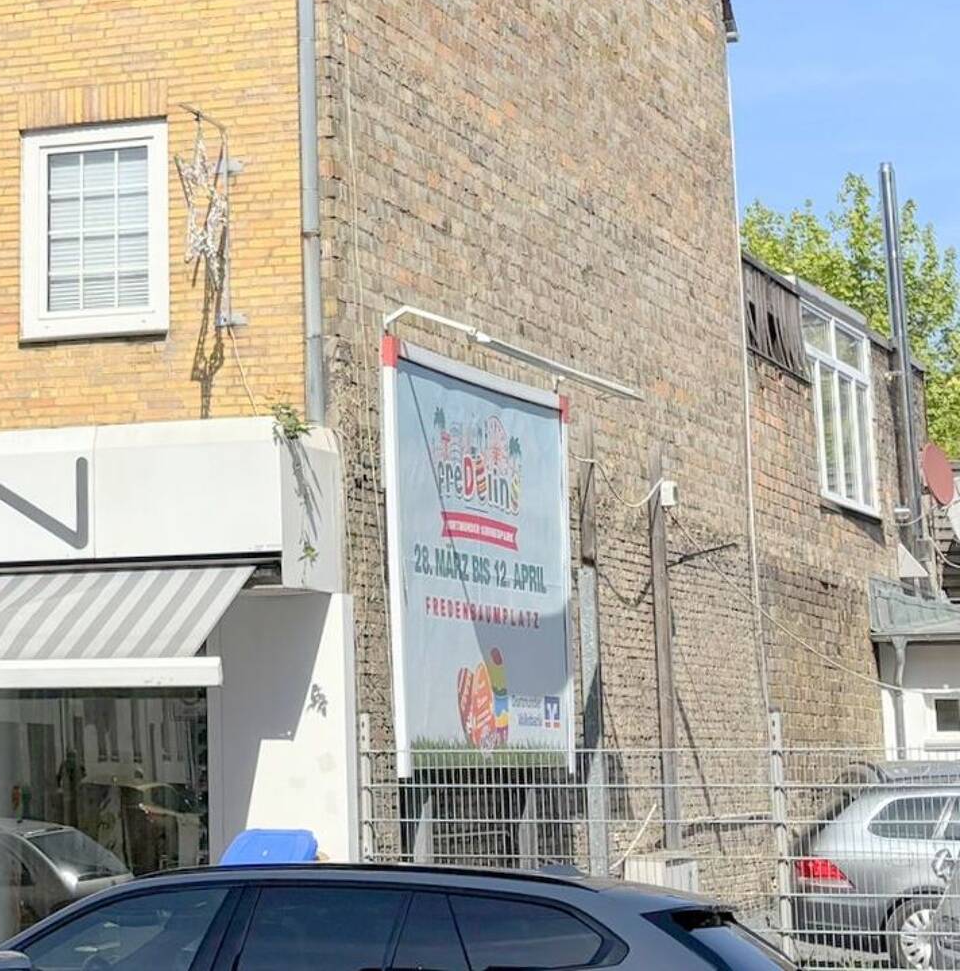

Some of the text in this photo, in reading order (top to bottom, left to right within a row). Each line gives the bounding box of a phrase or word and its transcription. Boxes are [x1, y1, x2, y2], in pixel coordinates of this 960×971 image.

[414, 543, 547, 593] 28. MÄRZ BIS 12. APRIL
[426, 596, 539, 628] FREDENBAUMPLATZ
